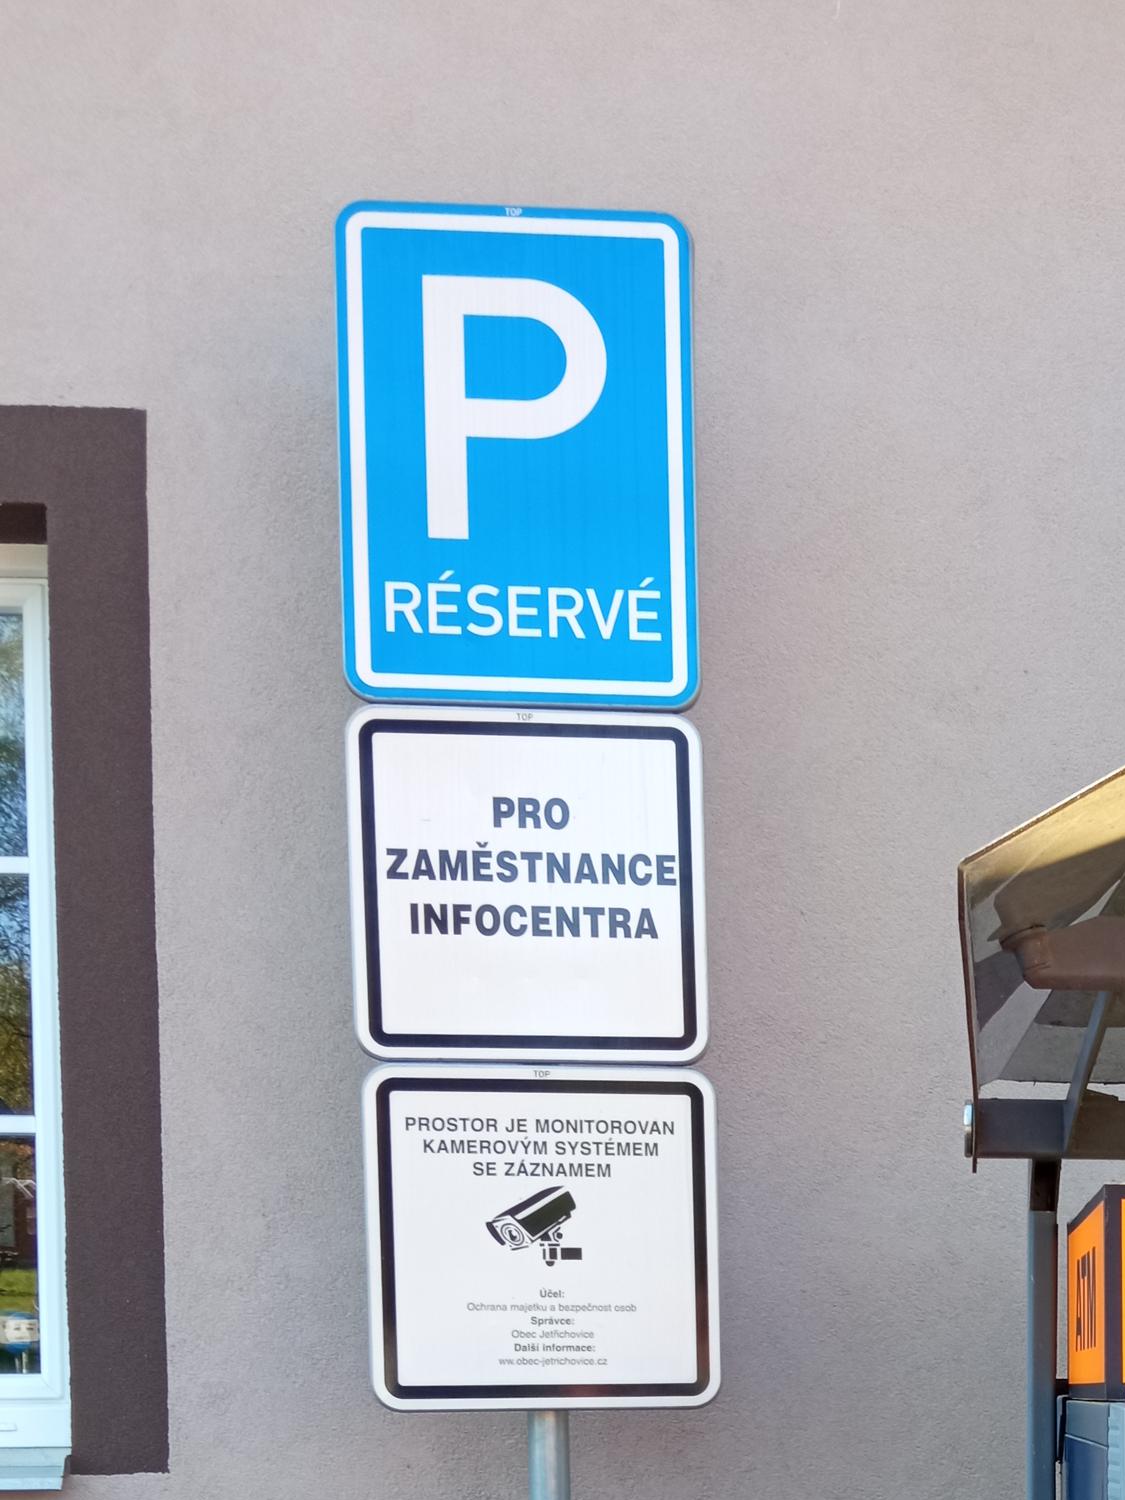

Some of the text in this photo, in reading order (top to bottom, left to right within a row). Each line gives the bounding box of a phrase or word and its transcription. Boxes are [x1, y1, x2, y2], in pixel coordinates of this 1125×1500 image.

[505, 207, 523, 217] TOP
[422, 274, 608, 540] P
[384, 570, 663, 642] RÉSERVÉ
[516, 712, 533, 721] TOP
[492, 796, 570, 830] PRO
[386, 841, 677, 886] ZAMĚSTNANCE
[410, 903, 659, 939] INFOCENTRA
[533, 1070, 551, 1078] TOP
[405, 1116, 675, 1135] PROSTOR JE MONITOROVAN
[423, 1136, 659, 1156] KAMEROVÝM SYSTÉMEM
[472, 1159, 612, 1178] SE ZÁZNAMEM
[539, 1287, 565, 1299] Účel:
[1075, 1246, 1097, 1352] ATM
[466, 1302, 507, 1312] Ochrana
[510, 1302, 547, 1313] majetku
[558, 1302, 612, 1313] bezpečnost
[614, 1303, 637, 1313] osob
[530, 1316, 575, 1327] Správce:
[511, 1329, 594, 1339] Obec Jetřichovice
[514, 1343, 596, 1352] Další informace:
